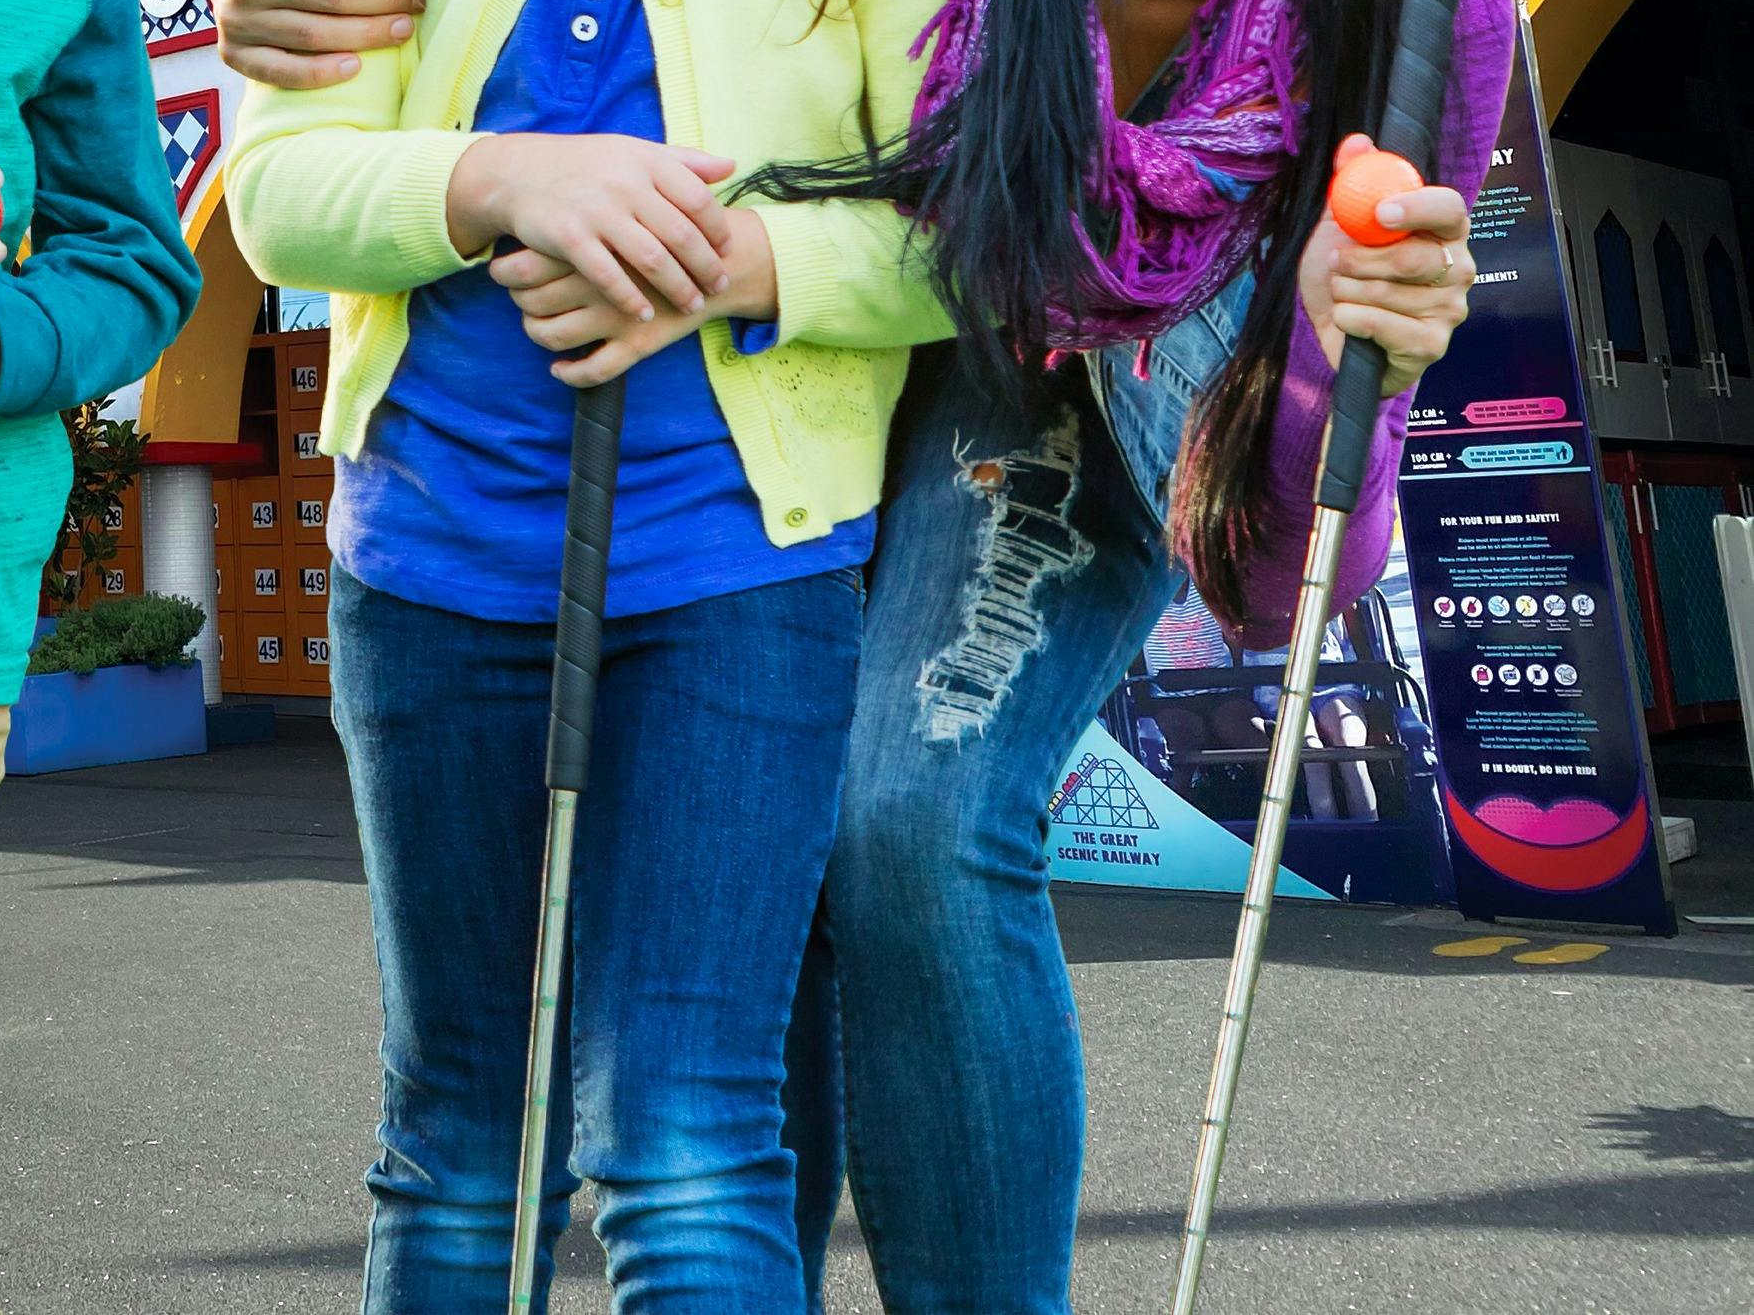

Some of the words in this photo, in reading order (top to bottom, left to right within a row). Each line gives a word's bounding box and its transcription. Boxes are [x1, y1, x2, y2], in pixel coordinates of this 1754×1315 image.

[1491, 148, 1514, 166] AY
[1474, 270, 1518, 284] REMENTS
[298, 370, 316, 389] 46
[1409, 410, 1421, 419] 10
[300, 436, 319, 455] 47
[104, 510, 121, 527] 28
[254, 505, 272, 525] 43
[303, 504, 323, 524] 48
[1440, 517, 1458, 526] FOR
[1459, 516, 1484, 525] YOUR
[1484, 515, 1503, 524] FUN
[1505, 514, 1524, 524] AND
[1525, 513, 1560, 523] SAFETY!
[107, 572, 123, 591] 29
[256, 572, 276, 592] 44
[305, 572, 325, 592] 49
[259, 640, 277, 660] 45
[309, 641, 329, 661] 50
[1482, 763, 1490, 773] IF
[1492, 764, 1503, 773] IN
[1505, 764, 1537, 776] DOUBT,
[1539, 765, 1553, 775] DO
[1554, 765, 1574, 775] NOT
[1575, 766, 1598, 776] RIDE
[1073, 832, 1096, 844] THE
[1099, 833, 1139, 847] GREAT
[1058, 847, 1099, 862] SCENIC
[1101, 849, 1160, 866] RAILWAY
